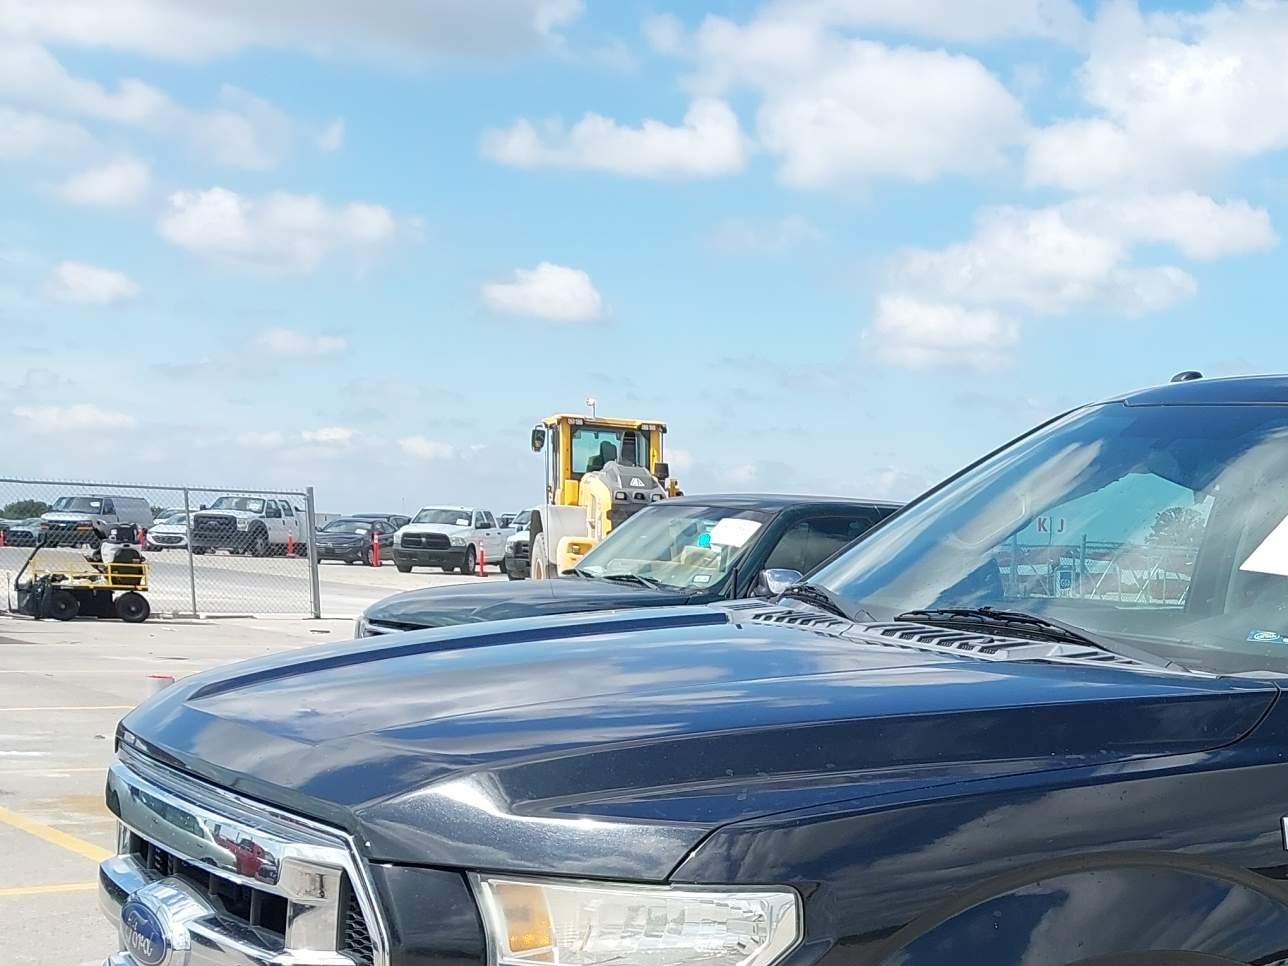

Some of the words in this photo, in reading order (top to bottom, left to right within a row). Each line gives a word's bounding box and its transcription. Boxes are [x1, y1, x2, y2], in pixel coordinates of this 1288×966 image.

[1038, 517, 1048, 532] K
[1057, 518, 1065, 533] J
[124, 909, 155, 957] Ford
